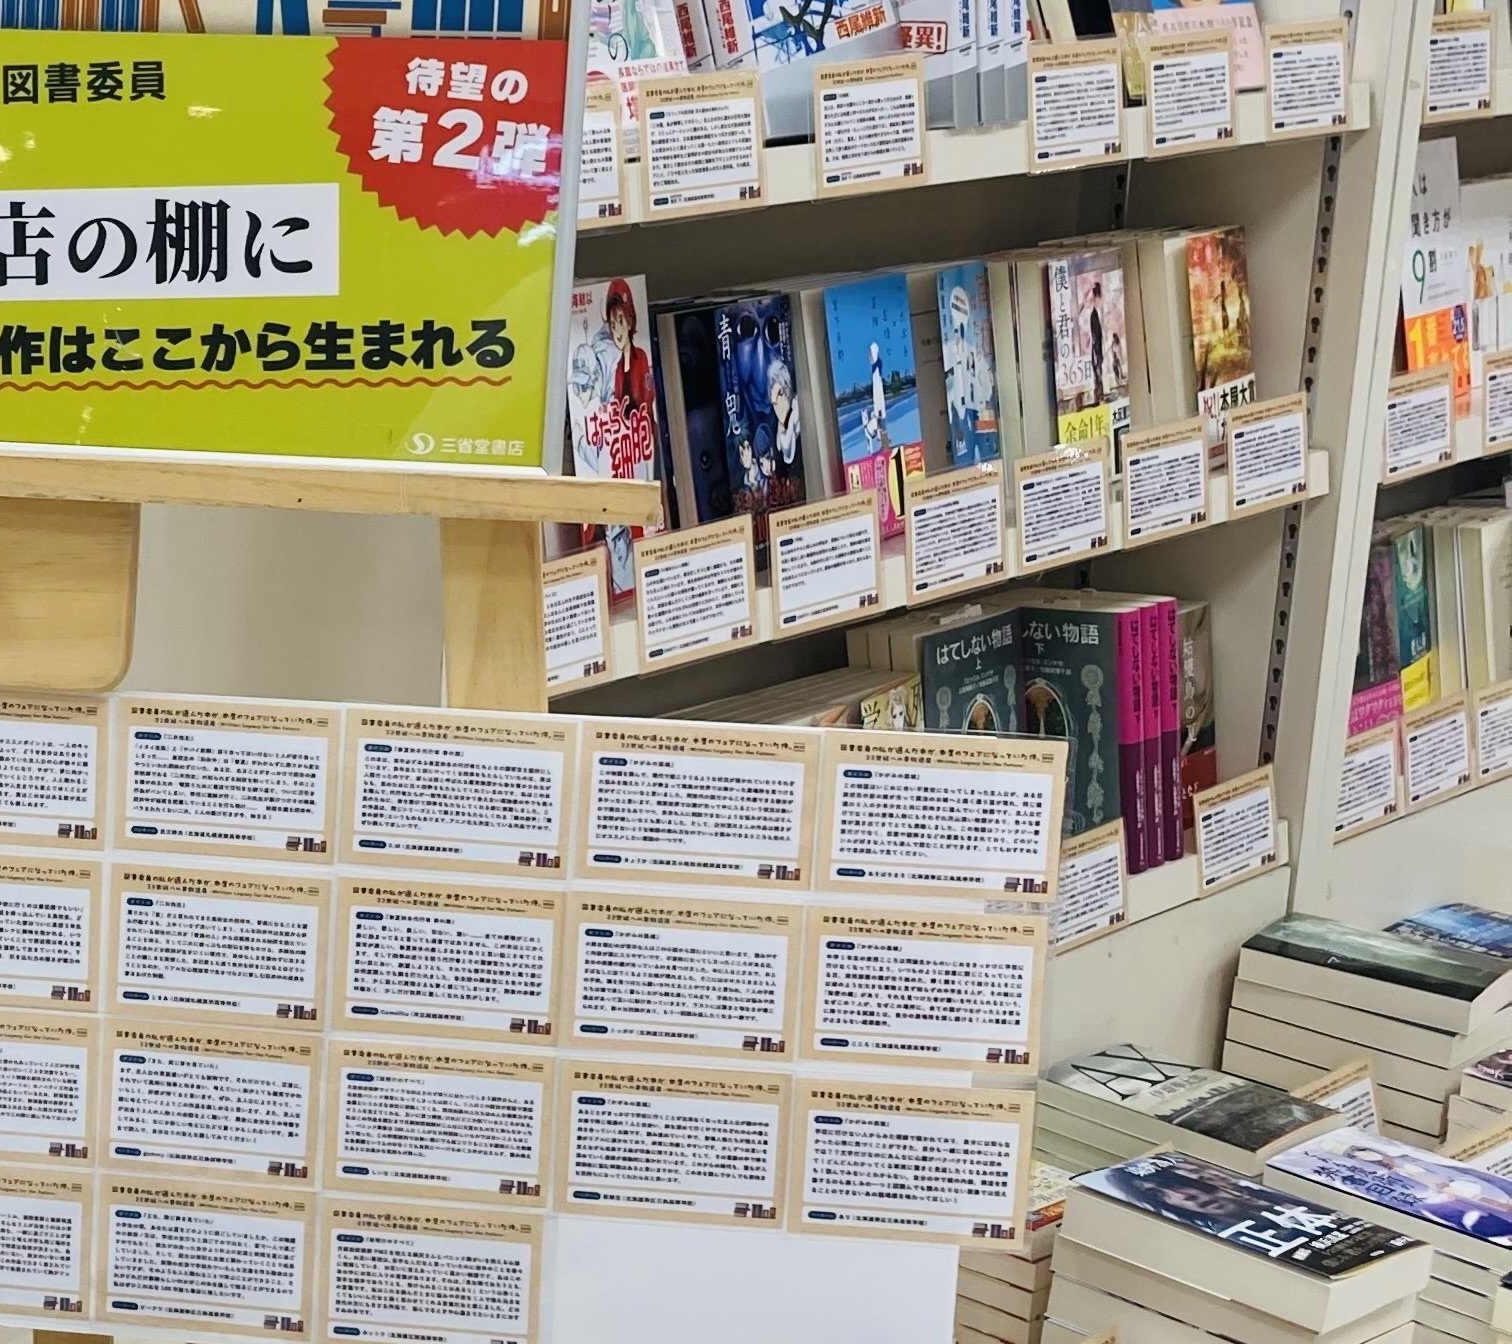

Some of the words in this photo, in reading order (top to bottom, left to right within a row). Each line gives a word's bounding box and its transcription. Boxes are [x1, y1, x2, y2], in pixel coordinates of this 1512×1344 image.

[834, 6, 886, 40] 西尾維新
[406, 59, 529, 103] 待望の
[368, 107, 551, 172] 第2弾
[440, 435, 526, 458] 三省堂書店
[936, 624, 1013, 665] はてしない物語
[1070, 1043, 1200, 1101] AX
[1216, 1205, 1338, 1258] 正体
